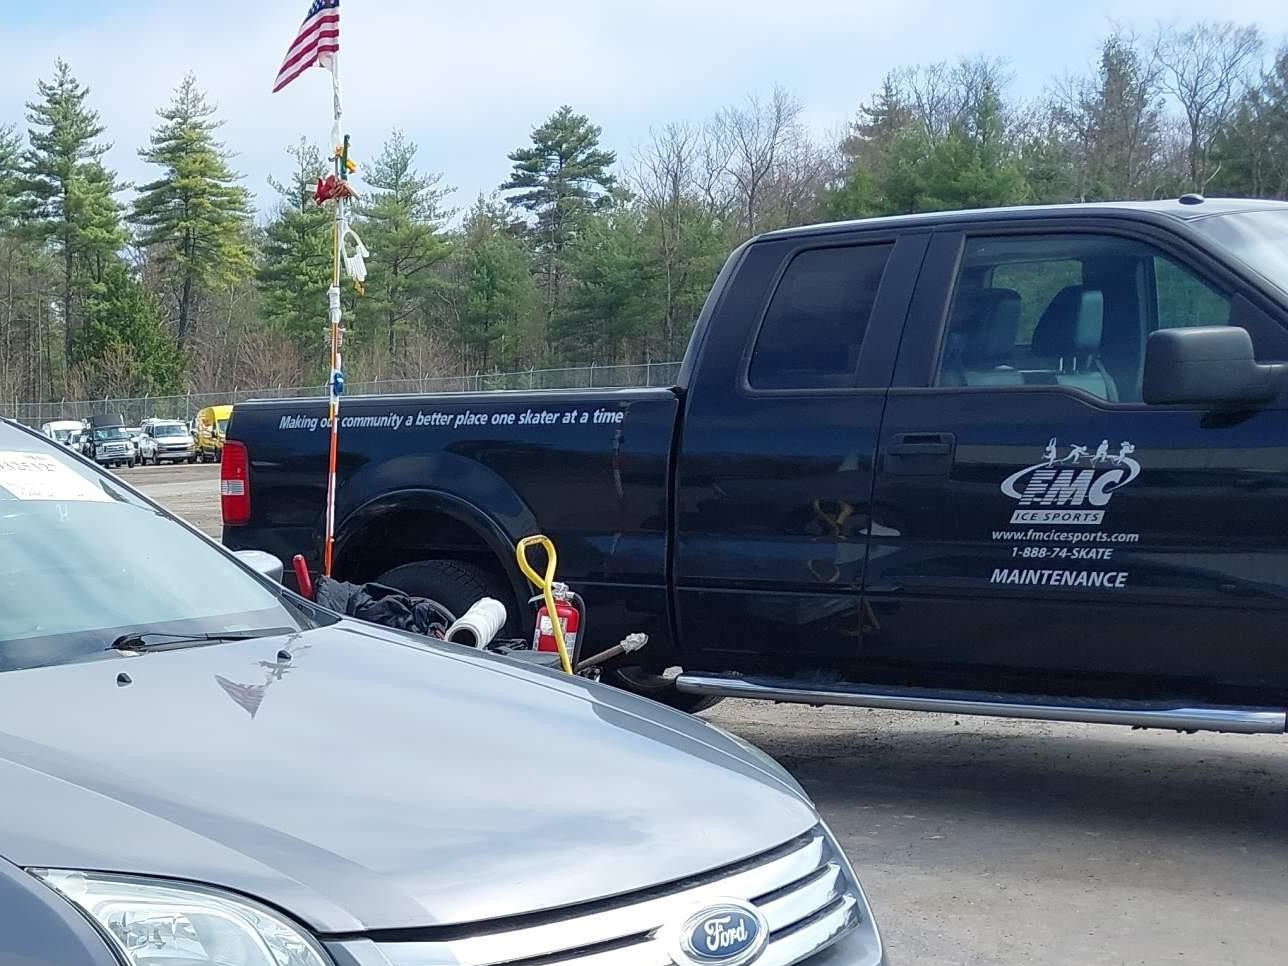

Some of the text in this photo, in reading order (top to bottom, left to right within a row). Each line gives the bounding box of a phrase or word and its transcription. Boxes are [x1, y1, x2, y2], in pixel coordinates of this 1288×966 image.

[279, 408, 624, 431] Making ou community a better place one skater at a time
[1018, 469, 1124, 506] FMC
[1015, 512, 1100, 522] ICE SPORTS
[992, 528, 1140, 543] www.fmcicesports.com
[1012, 546, 1114, 560] 1-888-74-SKATE
[990, 568, 1128, 588] MAINTENANCE
[704, 915, 748, 952] Ford
